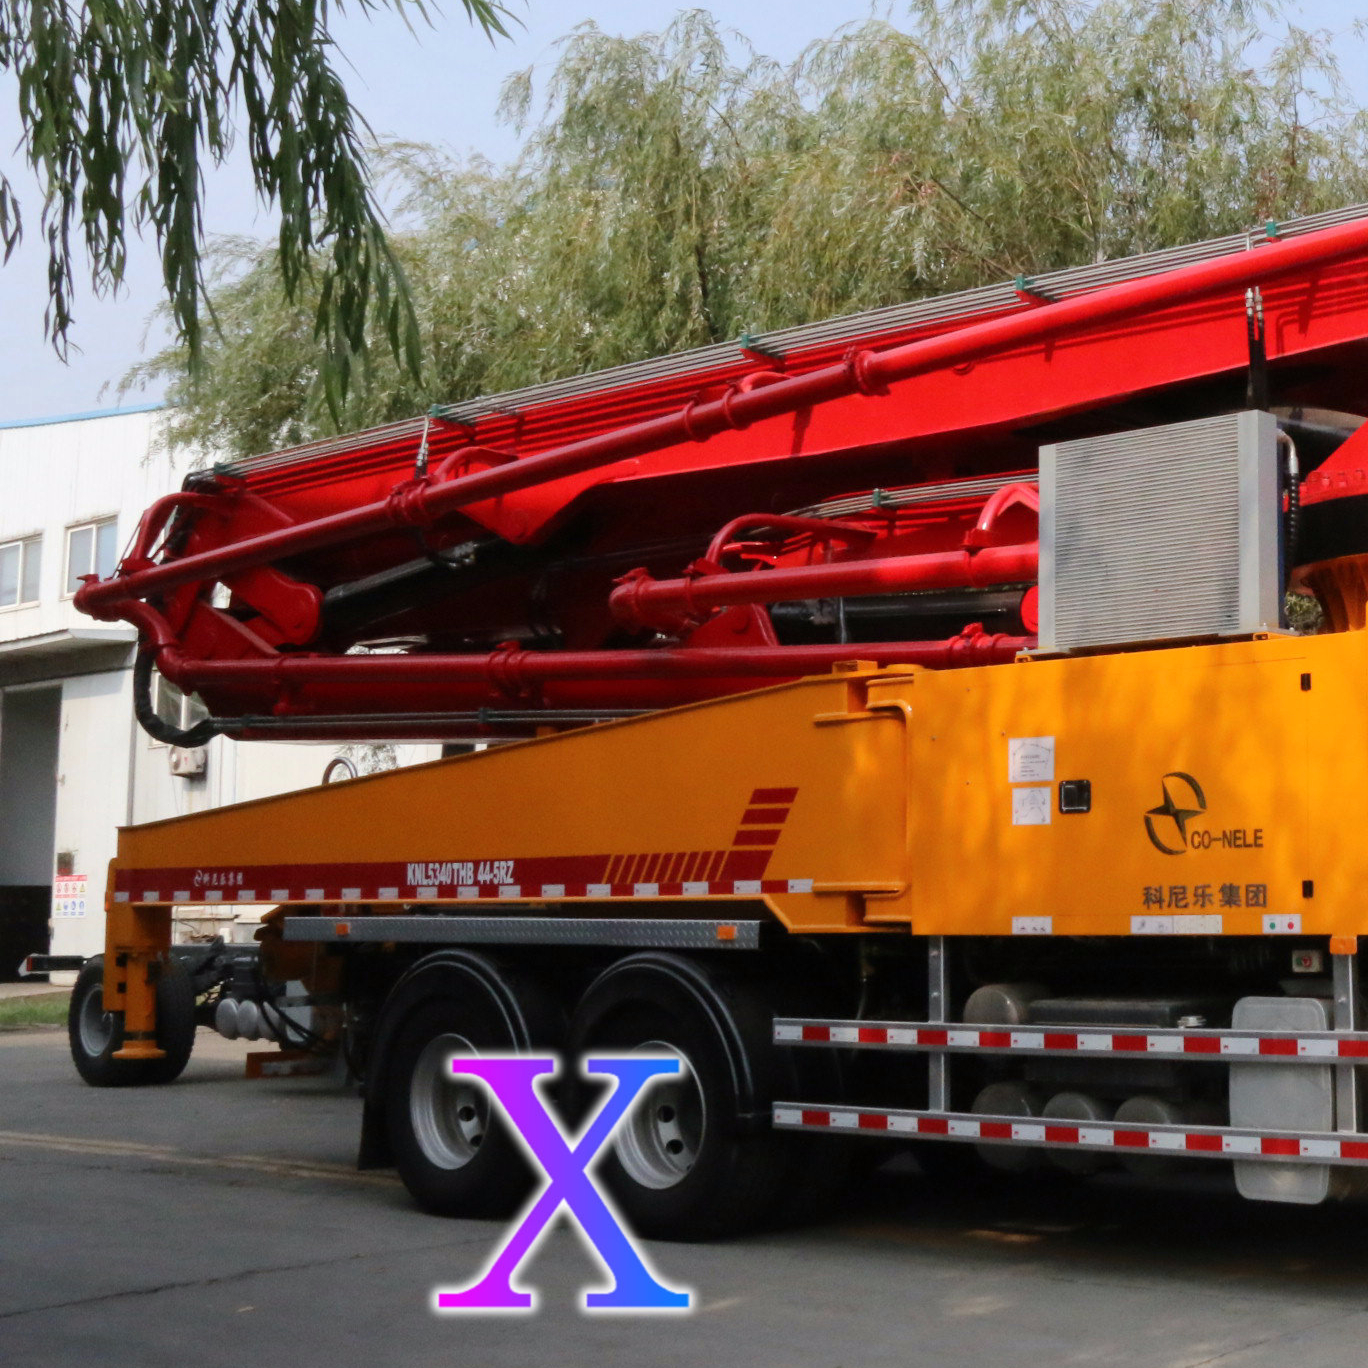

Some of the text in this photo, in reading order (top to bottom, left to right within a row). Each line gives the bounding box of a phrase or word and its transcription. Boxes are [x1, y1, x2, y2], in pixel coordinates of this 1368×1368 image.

[1190, 829, 1264, 849] CO-NELE
[407, 861, 514, 885] KNL5340THB 44-5RZ
[1143, 884, 1267, 909] 科尼乐集团
